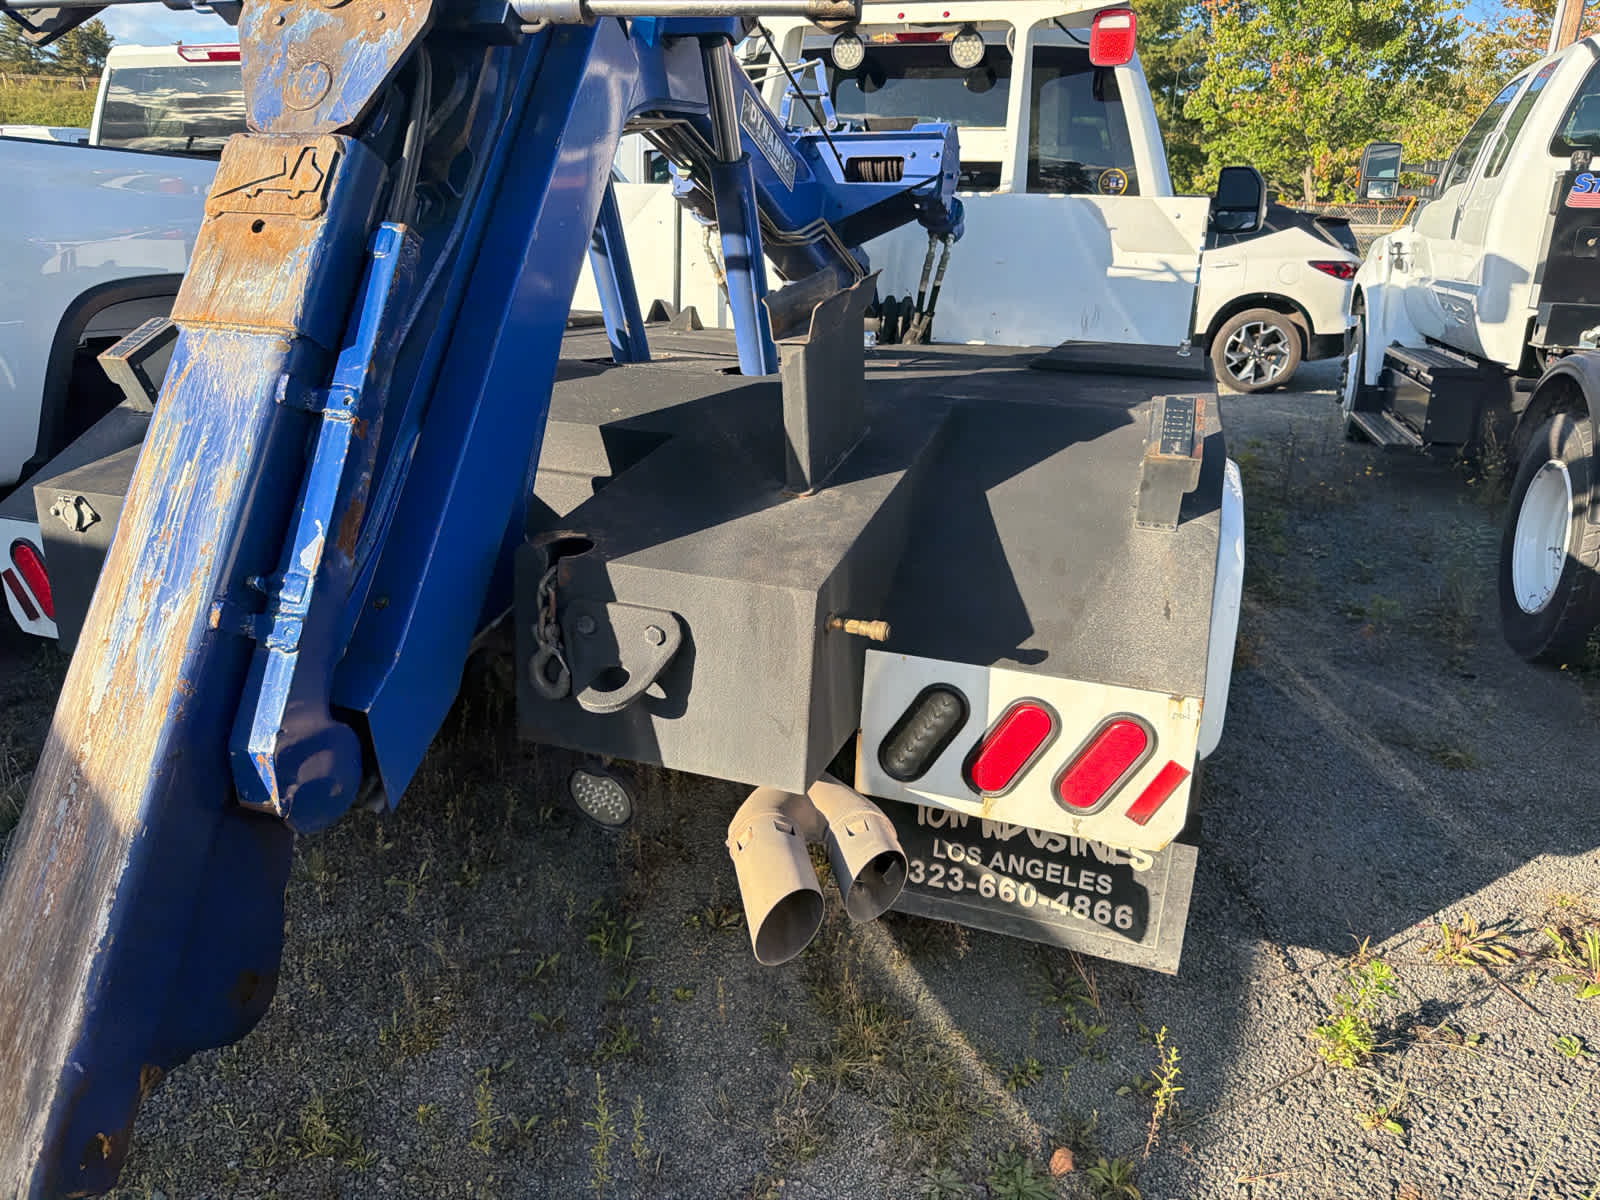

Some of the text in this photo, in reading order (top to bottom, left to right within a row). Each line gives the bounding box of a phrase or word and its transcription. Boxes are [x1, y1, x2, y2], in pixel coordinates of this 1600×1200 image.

[750, 103, 791, 171] DYNAMIC
[908, 860, 1134, 930] 323-660-4866
[932, 839, 1113, 895] LOS ANGELES
